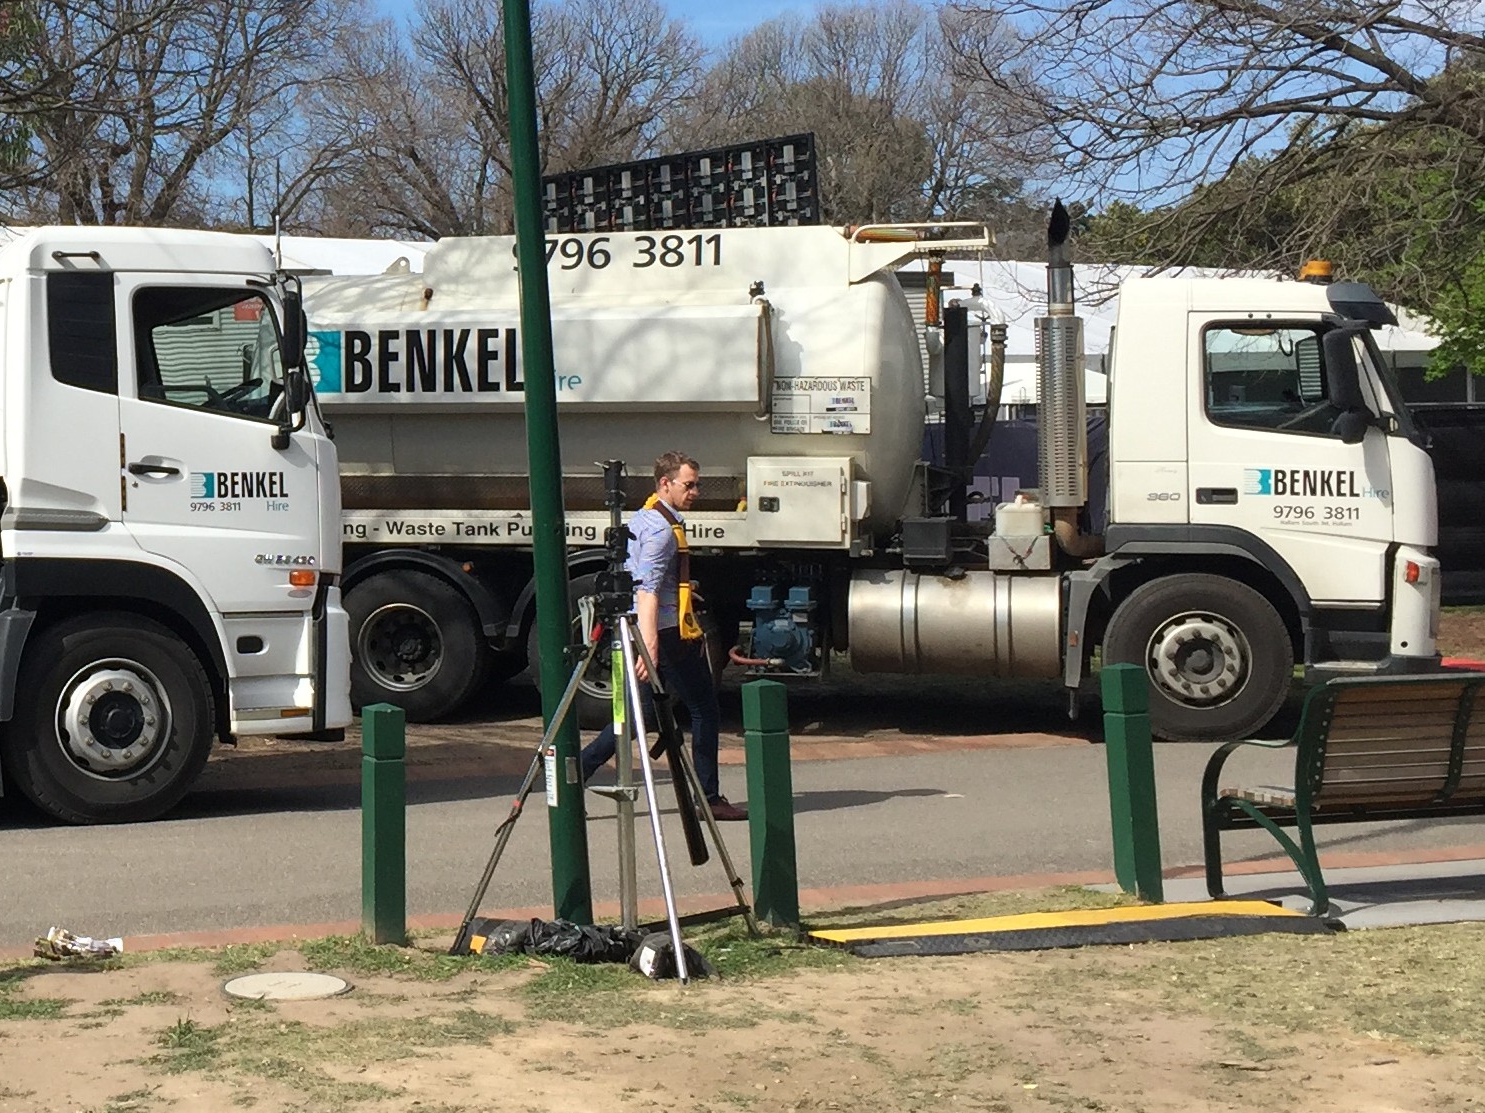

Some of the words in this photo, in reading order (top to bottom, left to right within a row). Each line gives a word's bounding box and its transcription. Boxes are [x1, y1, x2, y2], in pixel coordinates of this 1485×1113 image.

[512, 236, 611, 271] 796
[632, 233, 721, 268] 3811
[344, 328, 525, 394] BENKEL
[839, 380, 865, 392] WASTE
[216, 471, 289, 498] BENKEL
[1273, 469, 1361, 498] BENKEL
[1362, 486, 1390, 500] Hire
[190, 501, 215, 512] 9796
[219, 501, 241, 512] 3811
[266, 500, 289, 512] Hire
[1273, 504, 1316, 519] 9796
[1323, 506, 1361, 520] 3811
[385, 520, 446, 536] Waste
[451, 521, 501, 537] Tank
[507, 522, 597, 541] Puing
[684, 523, 725, 539] Hire
